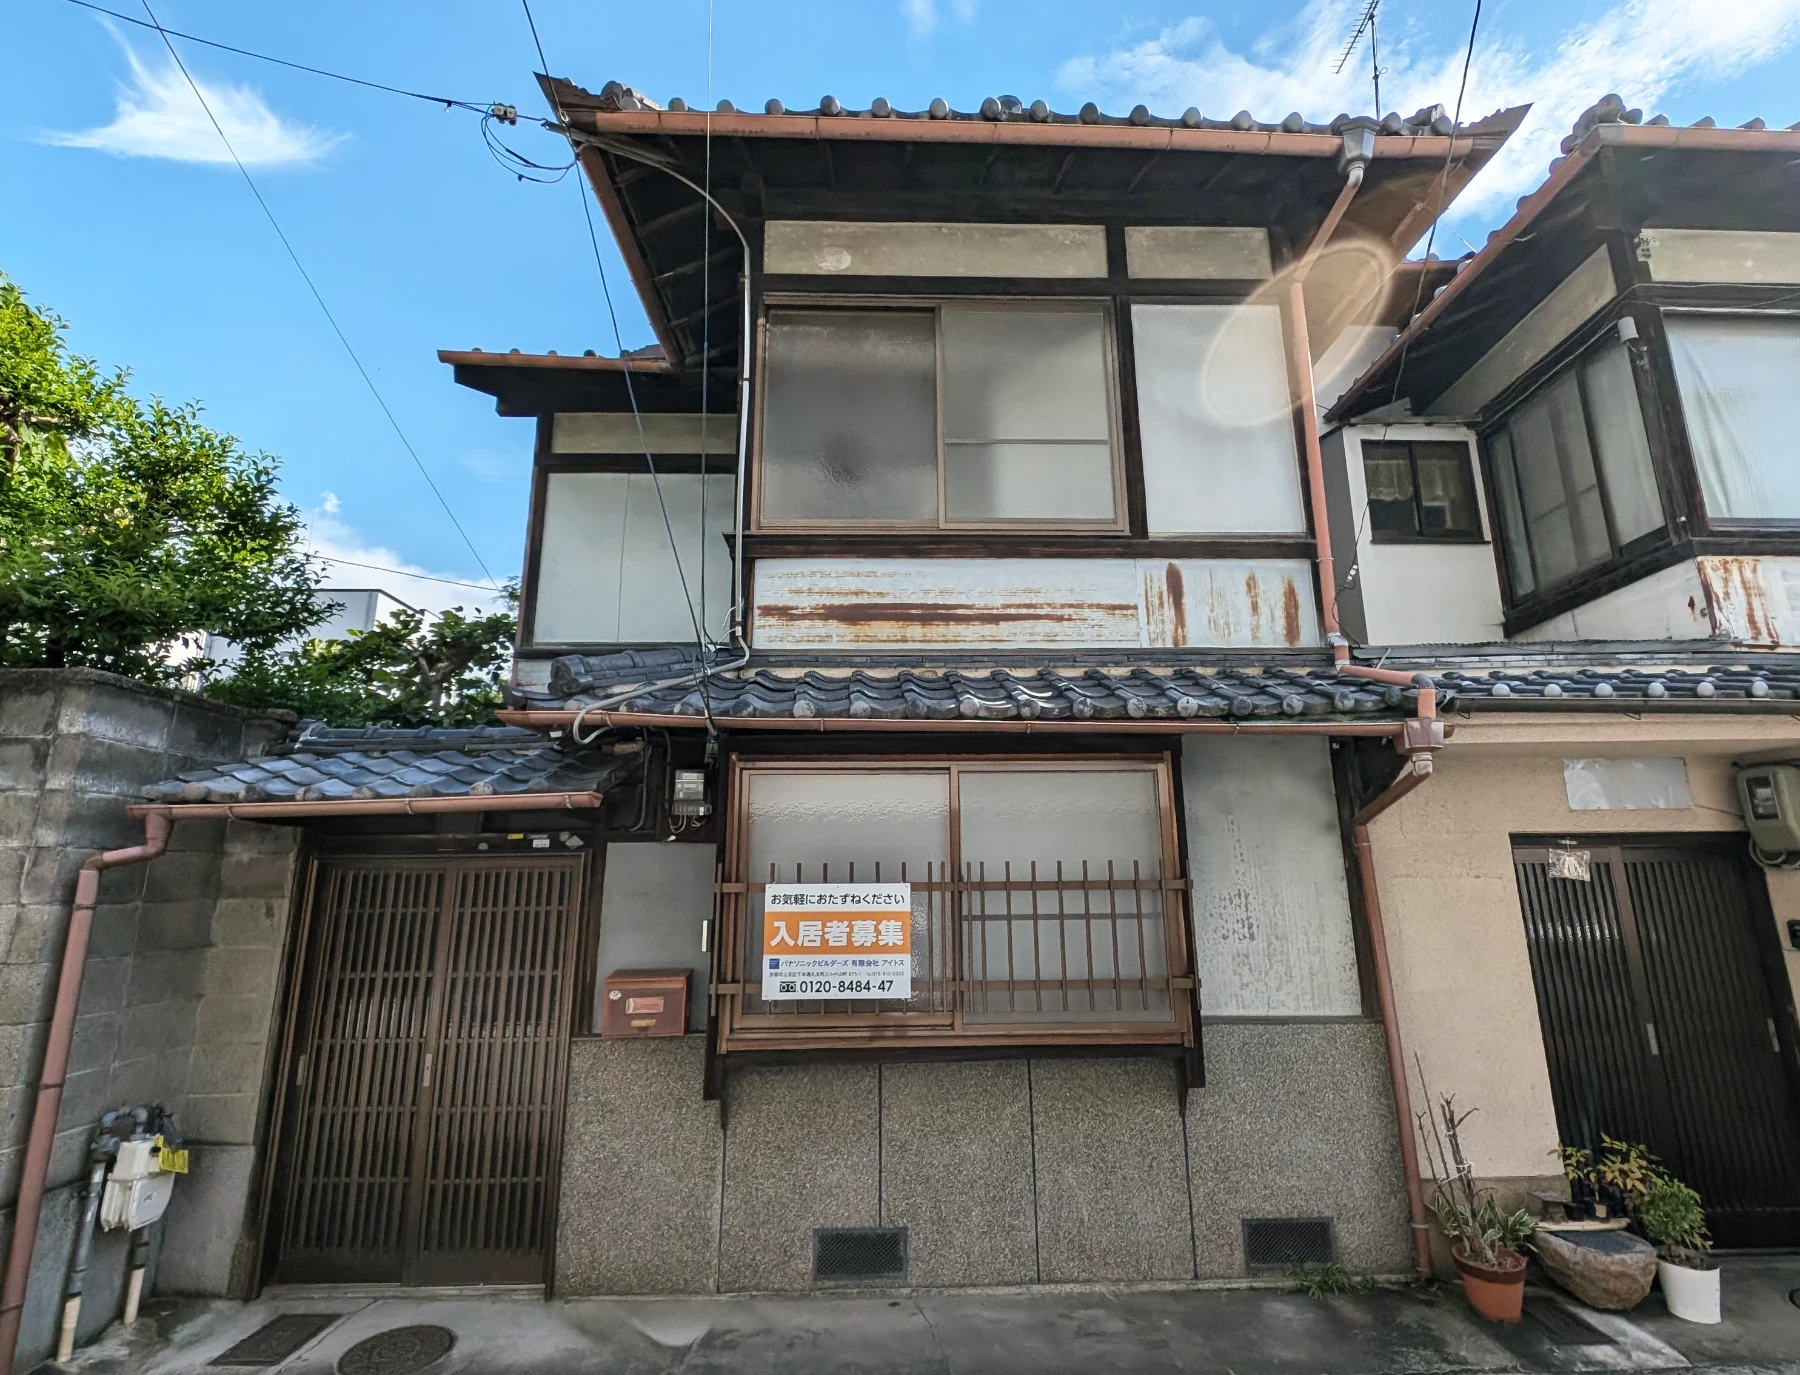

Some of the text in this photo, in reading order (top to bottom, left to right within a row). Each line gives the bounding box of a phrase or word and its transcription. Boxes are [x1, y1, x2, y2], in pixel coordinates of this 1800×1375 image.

[771, 893, 905, 905] お気軽におたずねください
[769, 920, 904, 947] 入居者募集
[780, 959, 849, 967] パナソニックビルダーズ
[851, 959, 879, 967] 有限会社
[881, 959, 904, 967] アイトス
[800, 980, 894, 993] 0120-8484-47
